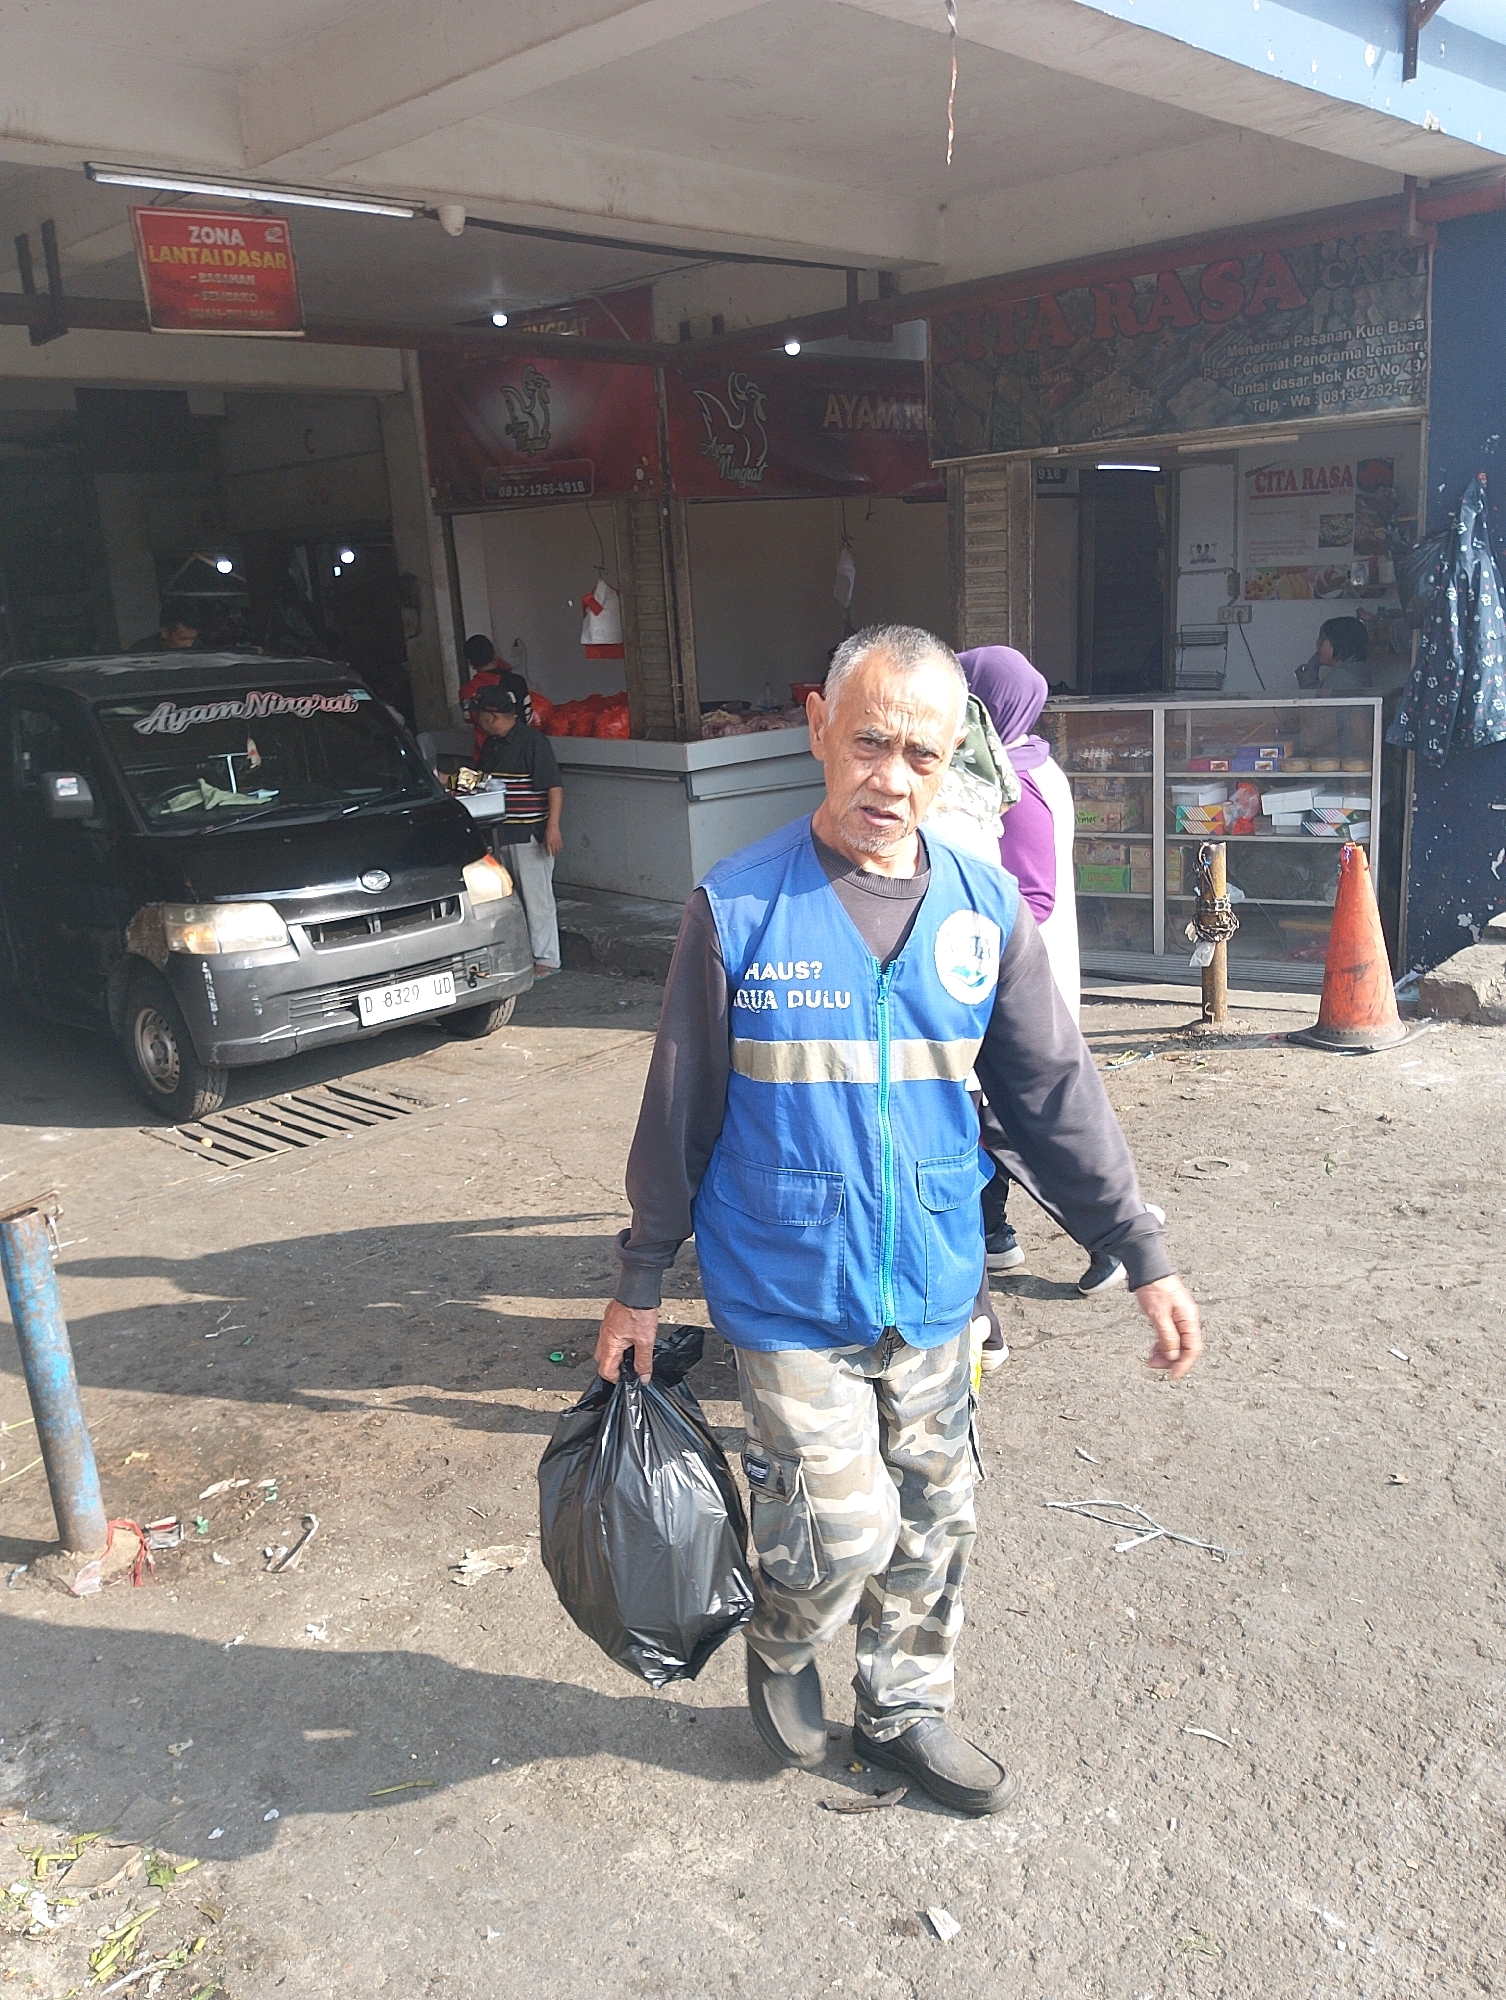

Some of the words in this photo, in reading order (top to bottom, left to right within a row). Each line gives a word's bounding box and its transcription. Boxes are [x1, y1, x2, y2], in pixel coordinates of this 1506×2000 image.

[188, 225, 245, 246] ZONA
[149, 245, 220, 266] LANTAI
[223, 251, 288, 269] DASAR
[1090, 250, 1308, 340] RASA
[1226, 340, 1290, 359] Menerima
[1294, 331, 1352, 348] Pesanan
[1356, 323, 1384, 340] Kue
[1203, 364, 1244, 381] Pasar
[1243, 356, 1290, 376] Cermat
[1293, 348, 1362, 368] Panorama
[1232, 379, 1269, 397] lantai
[1272, 374, 1310, 390] dasar
[1313, 368, 1342, 385] blok
[1346, 363, 1376, 381] KBT
[1380, 362, 1401, 379] No
[823, 393, 899, 430] AYAM
[1251, 397, 1279, 414] Telp
[1291, 393, 1310, 408] Wa
[702, 436, 735, 460] Ayam
[718, 455, 770, 488] Ningrat
[1254, 468, 1298, 493] CITA
[1302, 464, 1354, 491] RASA
[133, 701, 246, 735] Ayam
[244, 691, 359, 719] Ningrat
[744, 960, 823, 981] HAUS?
[364, 996, 373, 1013] D
[384, 984, 420, 1008] 8329
[433, 977, 452, 996] UD
[787, 989, 851, 1010] DULU
